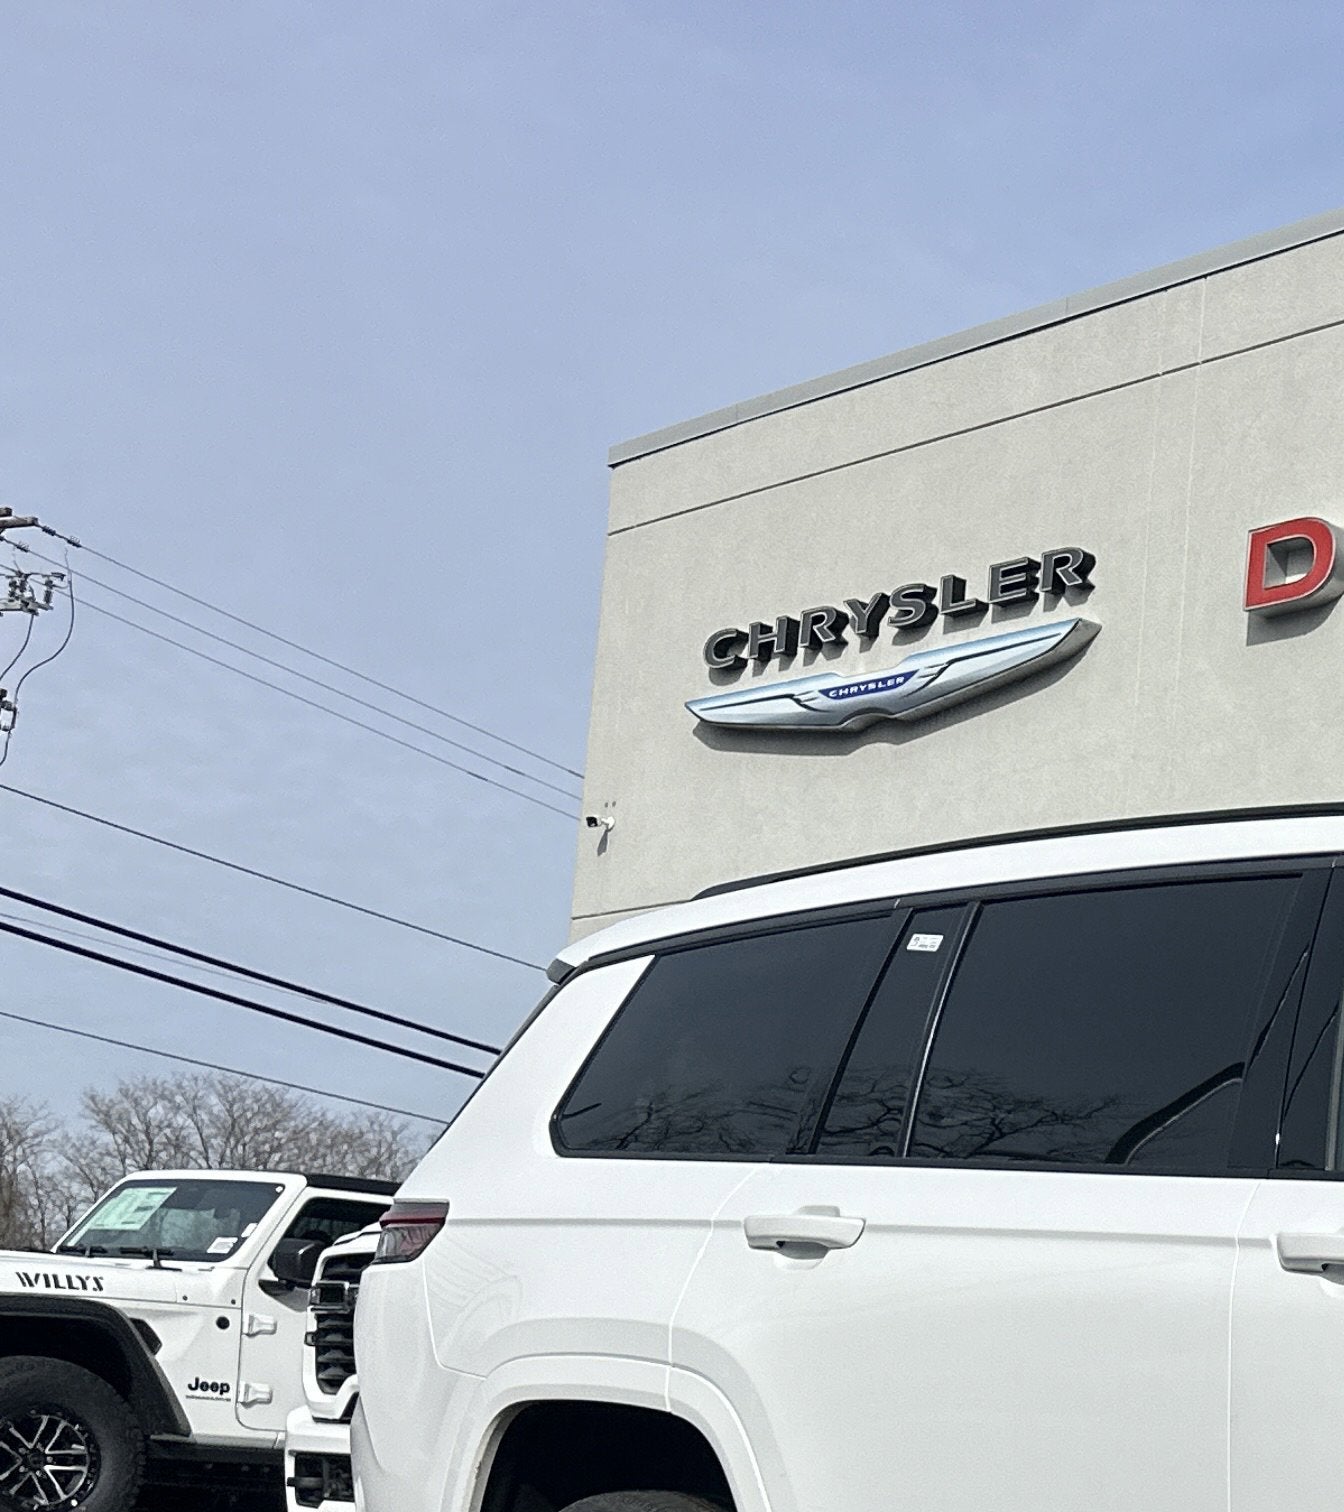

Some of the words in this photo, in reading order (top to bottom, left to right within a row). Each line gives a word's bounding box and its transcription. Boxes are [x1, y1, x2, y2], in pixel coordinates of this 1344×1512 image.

[702, 547, 1094, 671] CHRYSLER
[828, 676, 905, 697] CHRYSLER
[14, 1271, 104, 1292] WILLYS
[187, 1376, 231, 1396] Jeep
